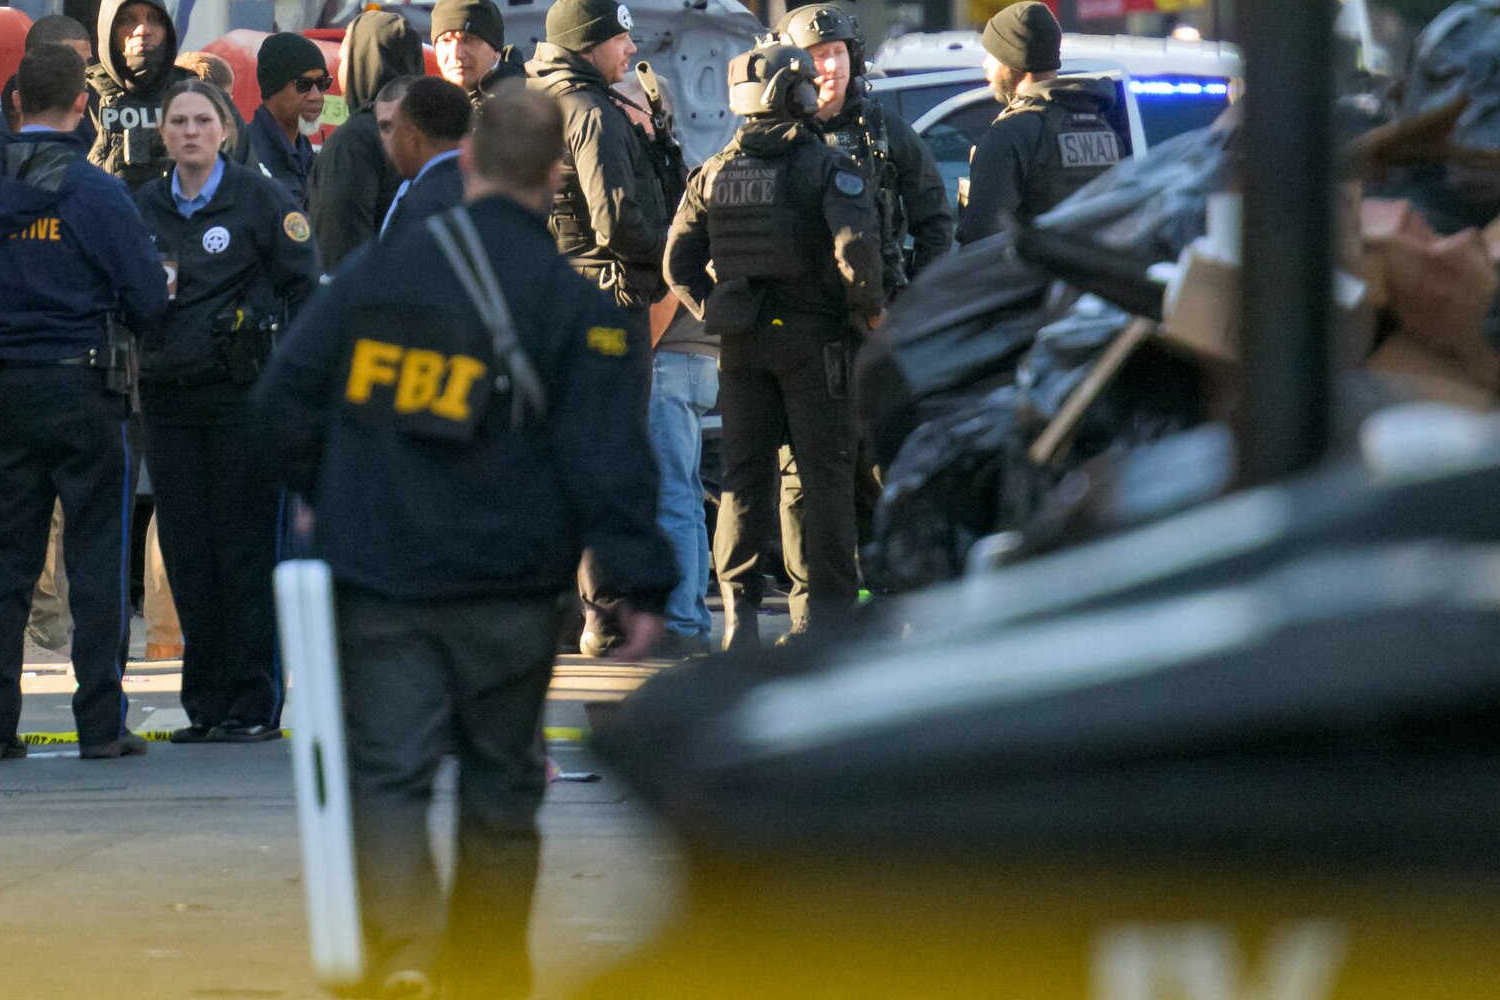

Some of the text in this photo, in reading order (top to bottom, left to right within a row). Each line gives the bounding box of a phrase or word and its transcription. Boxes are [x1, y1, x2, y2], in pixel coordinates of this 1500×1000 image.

[102, 106, 162, 130] POLI
[716, 179, 775, 206] OLICE
[345, 338, 488, 421] FBI
